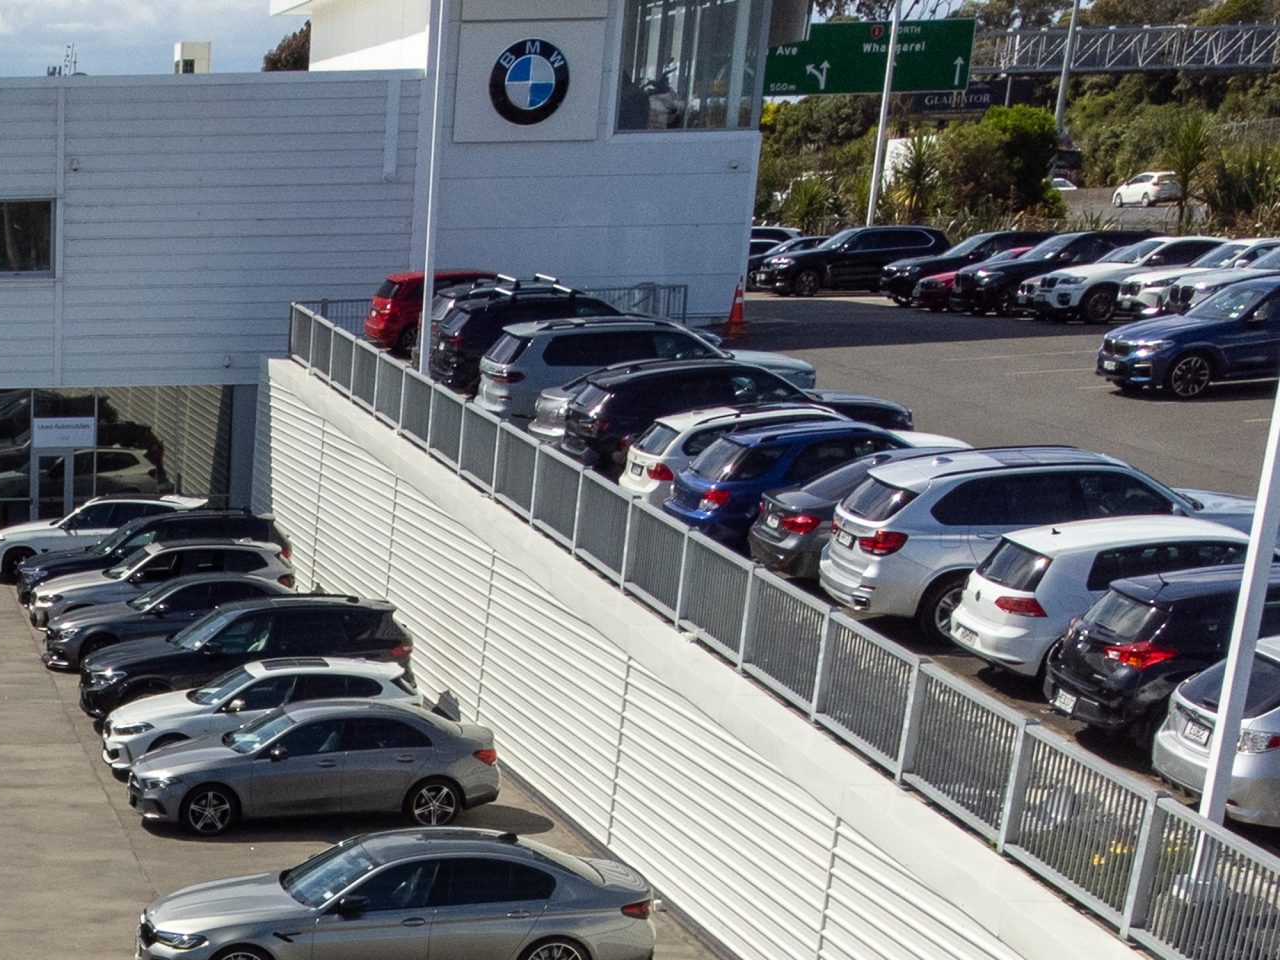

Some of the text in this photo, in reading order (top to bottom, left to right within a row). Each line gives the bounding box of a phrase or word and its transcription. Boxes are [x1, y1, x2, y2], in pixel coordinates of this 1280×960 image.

[888, 24, 922, 35] ORTH
[775, 45, 799, 56] Ave
[862, 41, 926, 55] Whagarei
[499, 40, 565, 69] BMW
[769, 82, 797, 92] 500m
